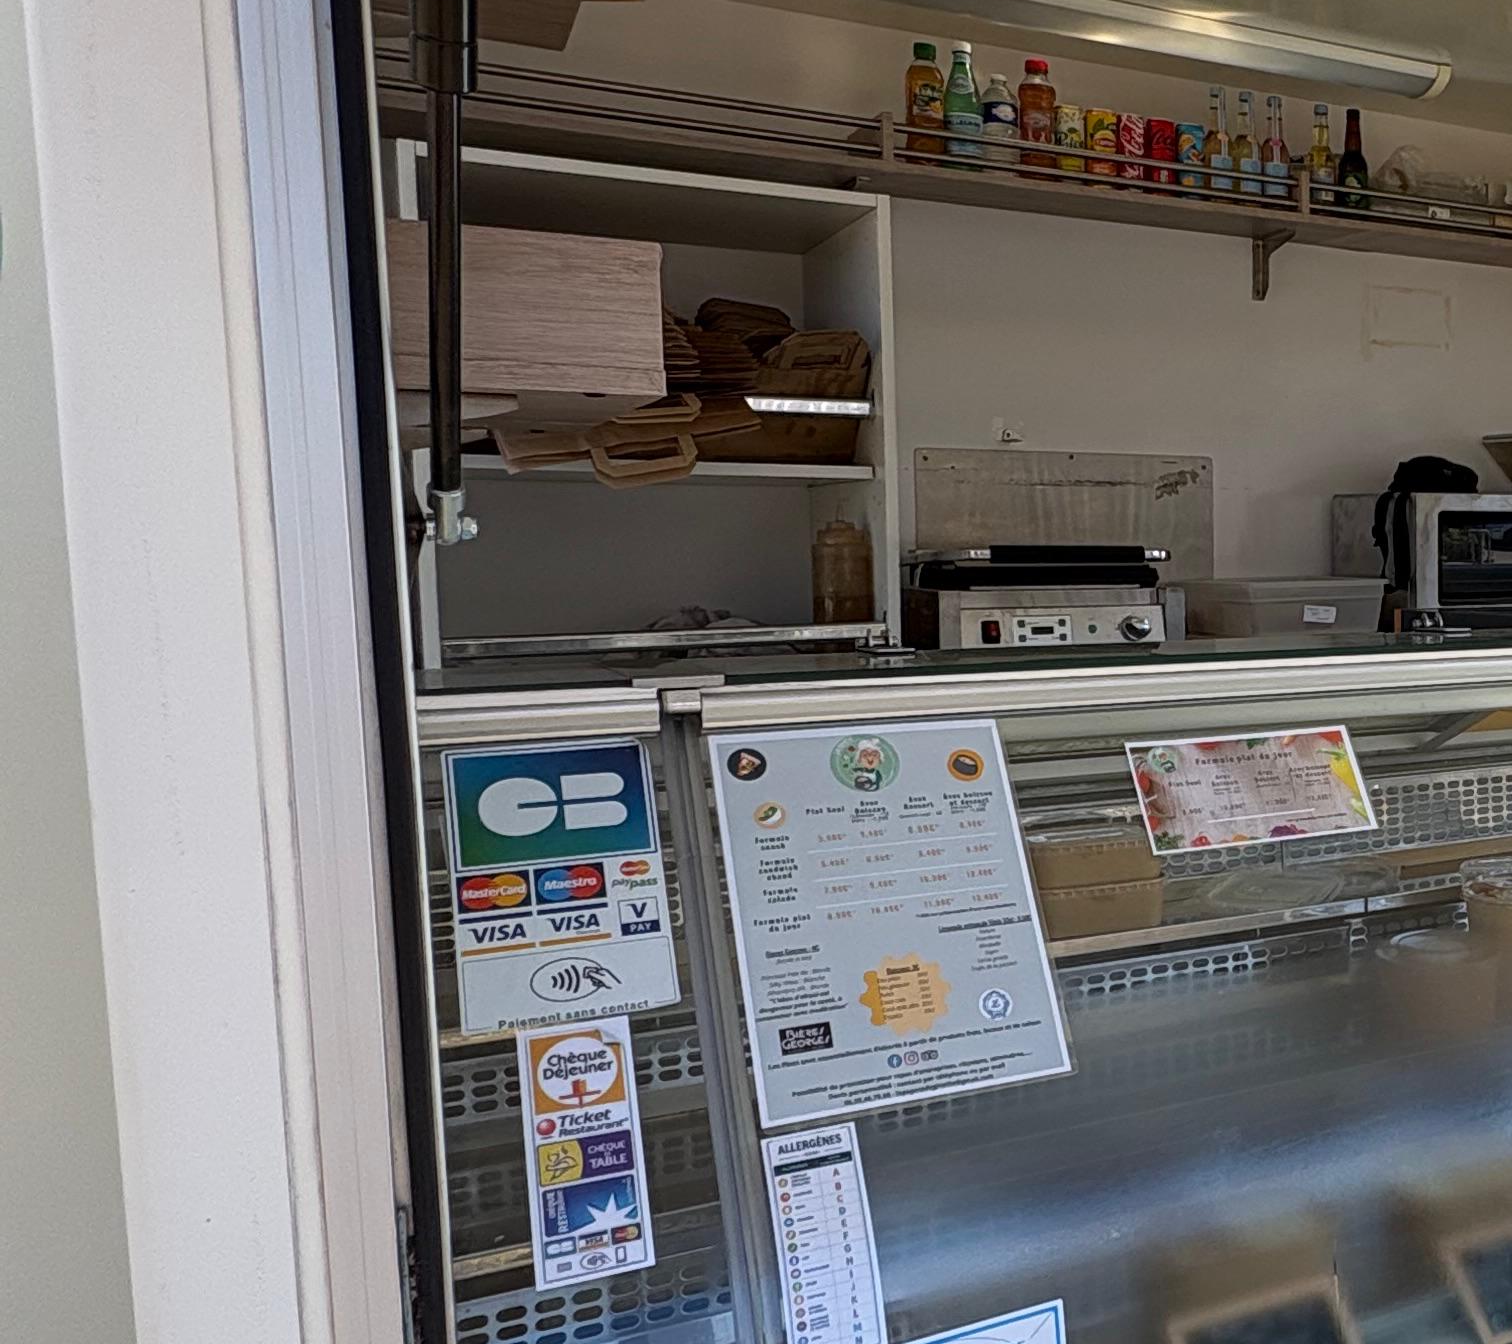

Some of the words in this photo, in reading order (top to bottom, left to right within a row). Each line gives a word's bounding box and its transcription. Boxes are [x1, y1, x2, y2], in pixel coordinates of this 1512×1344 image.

[478, 771, 628, 837] CB
[462, 884, 528, 900] MasterCard
[543, 877, 597, 891] Maestro
[630, 902, 648, 919] V
[546, 913, 601, 933] VISA
[629, 922, 652, 933] PAY
[468, 923, 528, 944] VISA
[498, 1011, 561, 1030] Paiement
[565, 1007, 597, 1020] sans
[601, 999, 649, 1015] contact
[782, 1034, 830, 1050] GEORGES
[546, 1049, 607, 1067] Chèque
[543, 1059, 614, 1081] Déjeuner
[558, 1109, 612, 1129] Ticket
[776, 1134, 842, 1155] ALLERGÈNES
[588, 1152, 628, 1170] TABLE
